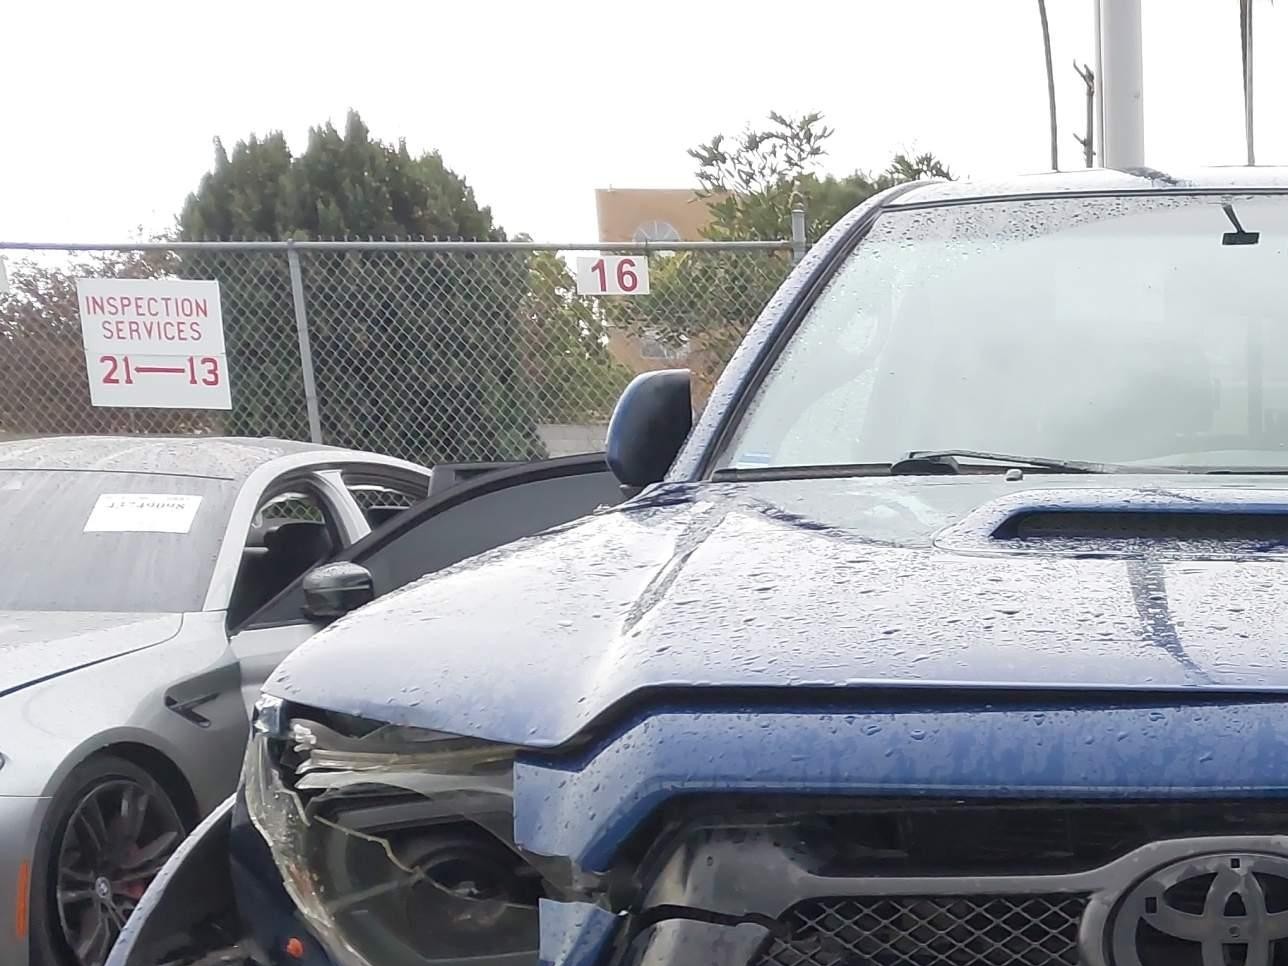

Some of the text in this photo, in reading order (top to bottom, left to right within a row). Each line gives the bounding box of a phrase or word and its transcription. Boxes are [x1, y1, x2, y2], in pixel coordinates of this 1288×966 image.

[591, 258, 638, 292] 16
[84, 295, 208, 318] INSPECTION
[101, 320, 203, 341] SERVICES
